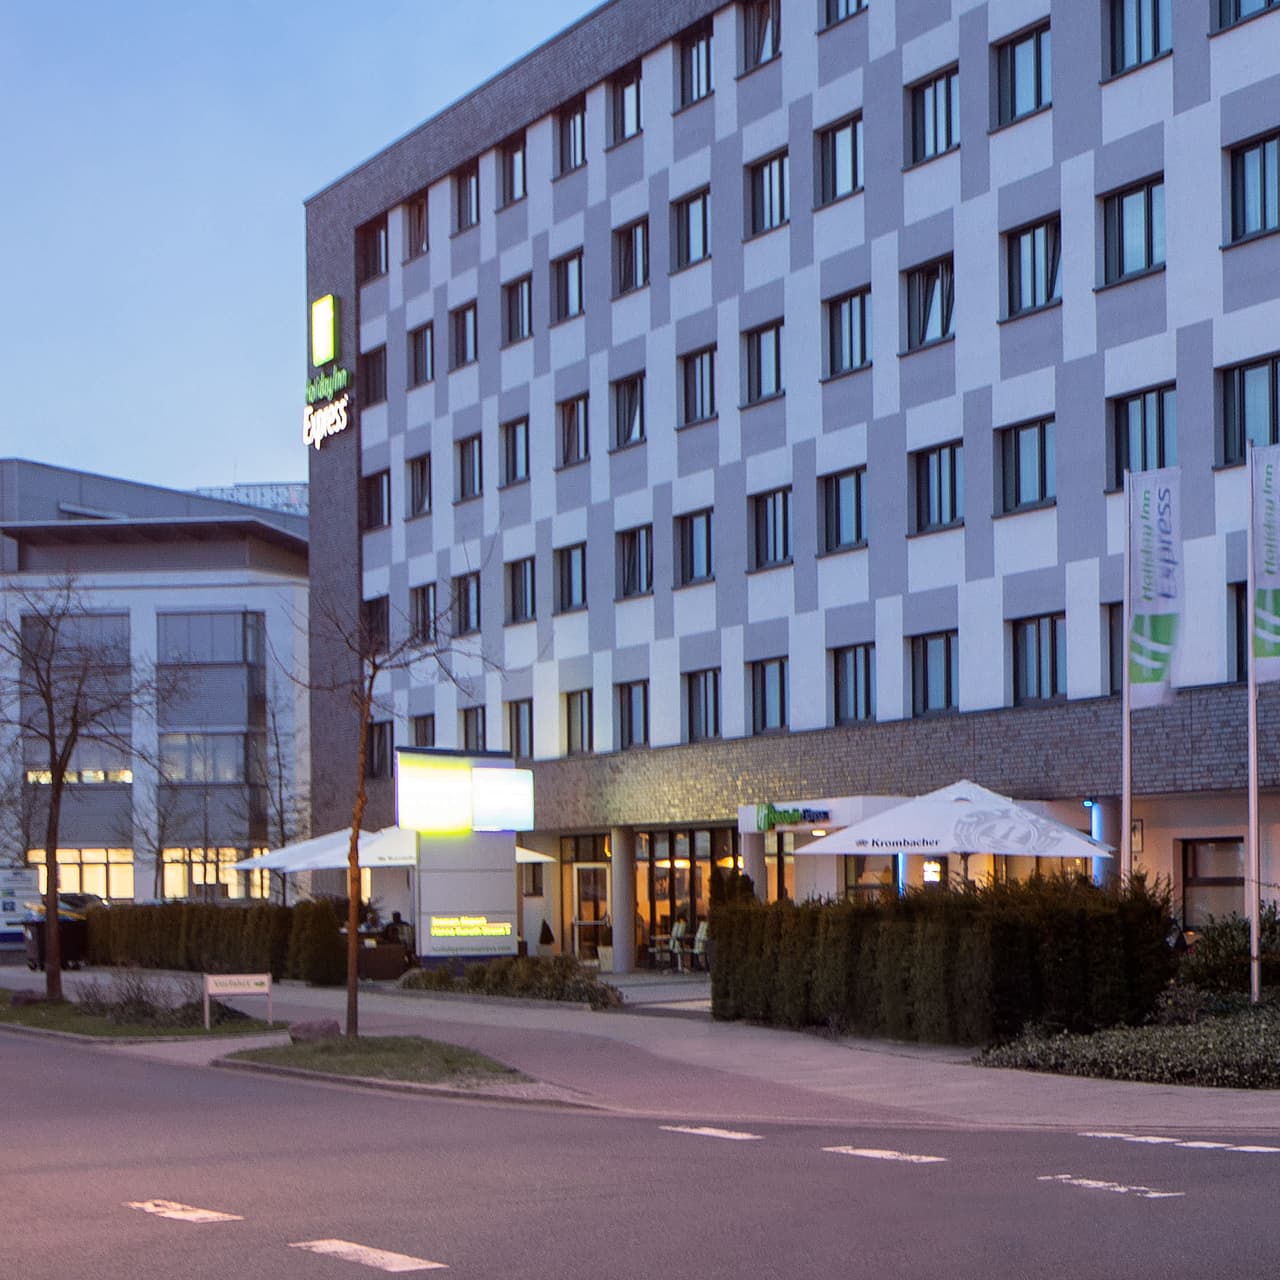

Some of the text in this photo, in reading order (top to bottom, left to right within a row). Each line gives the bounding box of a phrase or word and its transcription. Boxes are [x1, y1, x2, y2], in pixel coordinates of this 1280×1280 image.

[302, 395, 349, 451] Express
[1157, 486, 1179, 600] Express
[871, 836, 940, 849] Krombacher
